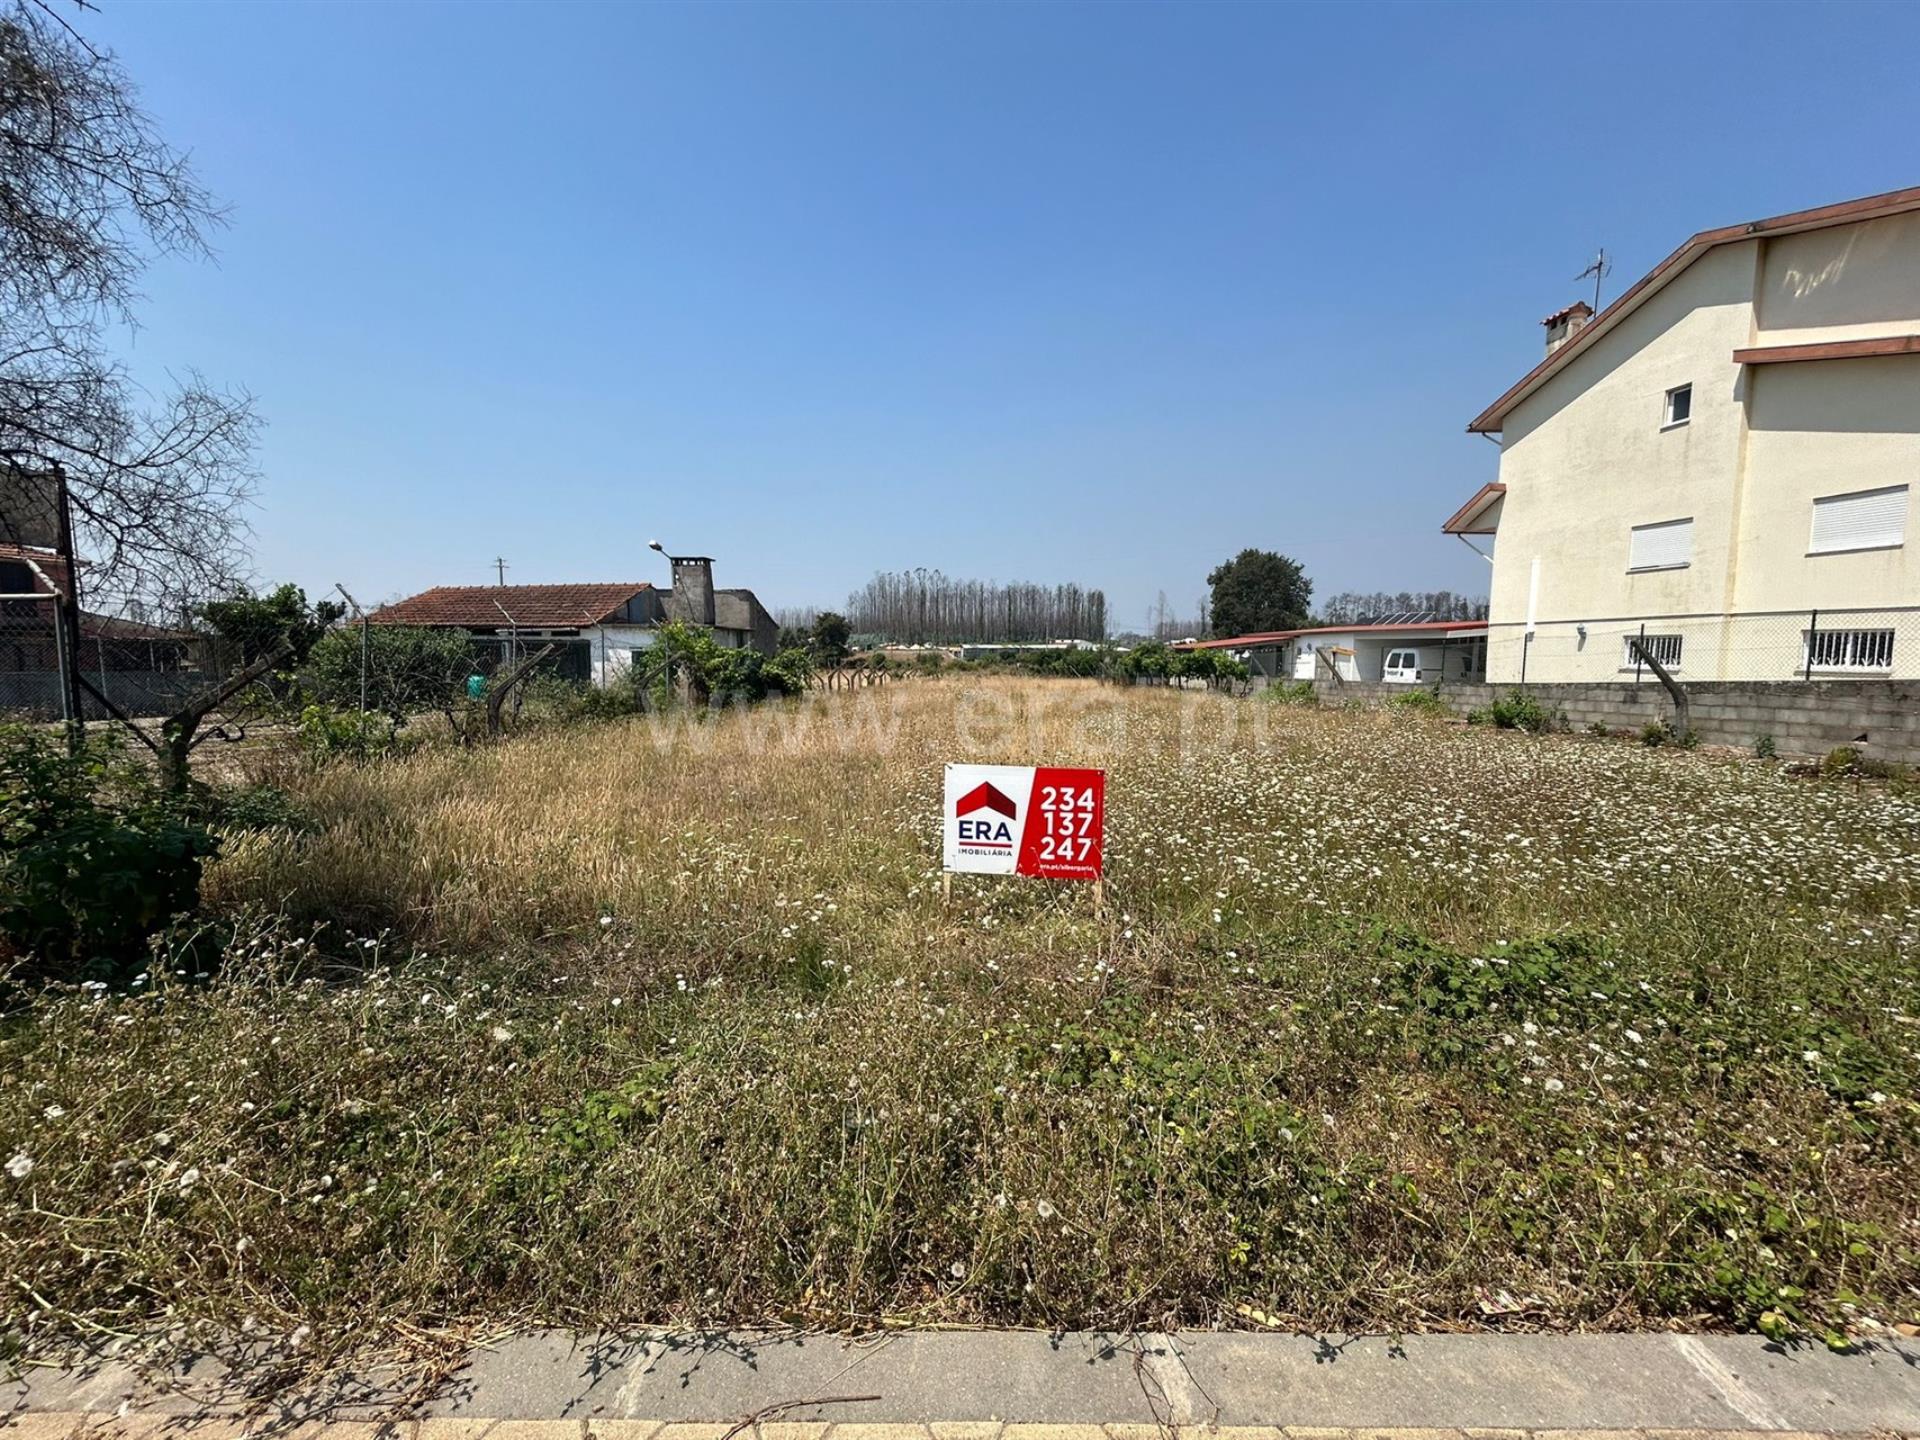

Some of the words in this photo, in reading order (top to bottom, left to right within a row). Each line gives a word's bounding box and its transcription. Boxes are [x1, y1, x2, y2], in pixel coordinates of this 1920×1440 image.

[1041, 786, 1095, 812] 234
[959, 820, 1012, 841] ERA
[1043, 811, 1093, 836] 137
[958, 848, 1012, 857] IMOBILIÁRIA
[1040, 836, 1092, 861] 247
